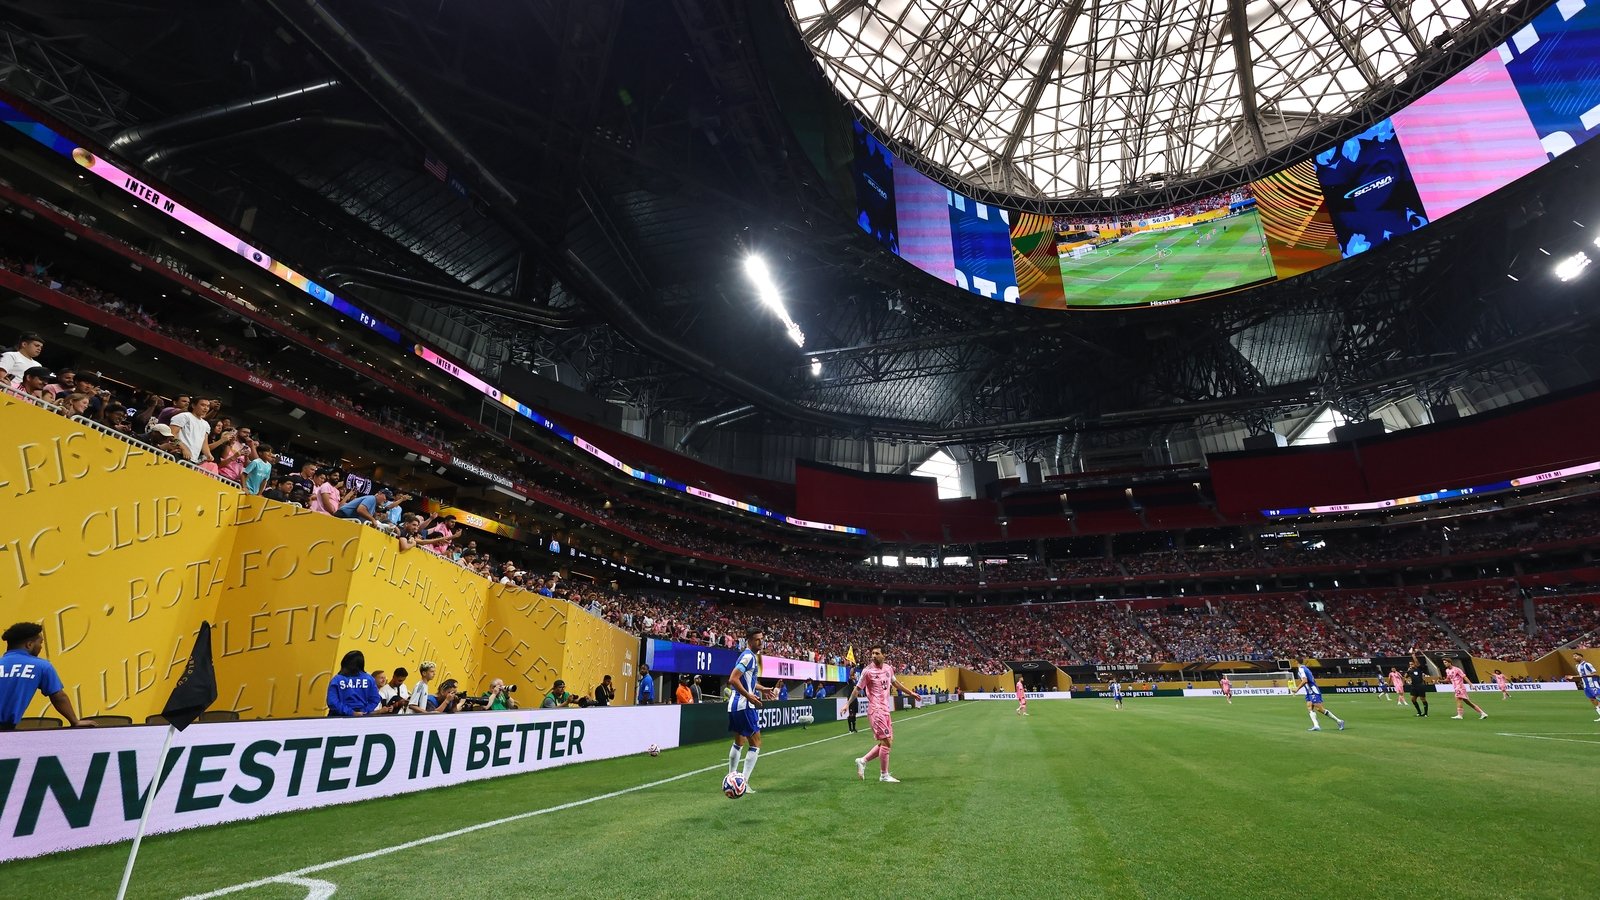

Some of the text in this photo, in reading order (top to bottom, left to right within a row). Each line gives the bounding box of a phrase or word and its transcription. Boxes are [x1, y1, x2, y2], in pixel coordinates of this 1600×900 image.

[125, 178, 160, 205] INTER
[1152, 216, 1170, 224] 56:33
[360, 312, 369, 324] FC
[436, 357, 452, 371] INTER
[248, 375, 273, 389] 208-209
[452, 456, 493, 480] Mercedes-Benz
[492, 473, 514, 489] Stadium
[1536, 472, 1552, 480] INTER
[81, 496, 183, 557] CLUB
[128, 536, 364, 622] BOTAFOGO
[164, 601, 366, 681] ALÉTICO
[697, 652, 705, 670] FC
[756, 708, 781, 728] ESTED
[783, 707, 790, 725] IN
[0, 720, 585, 837] INVESTED IN BETTER
